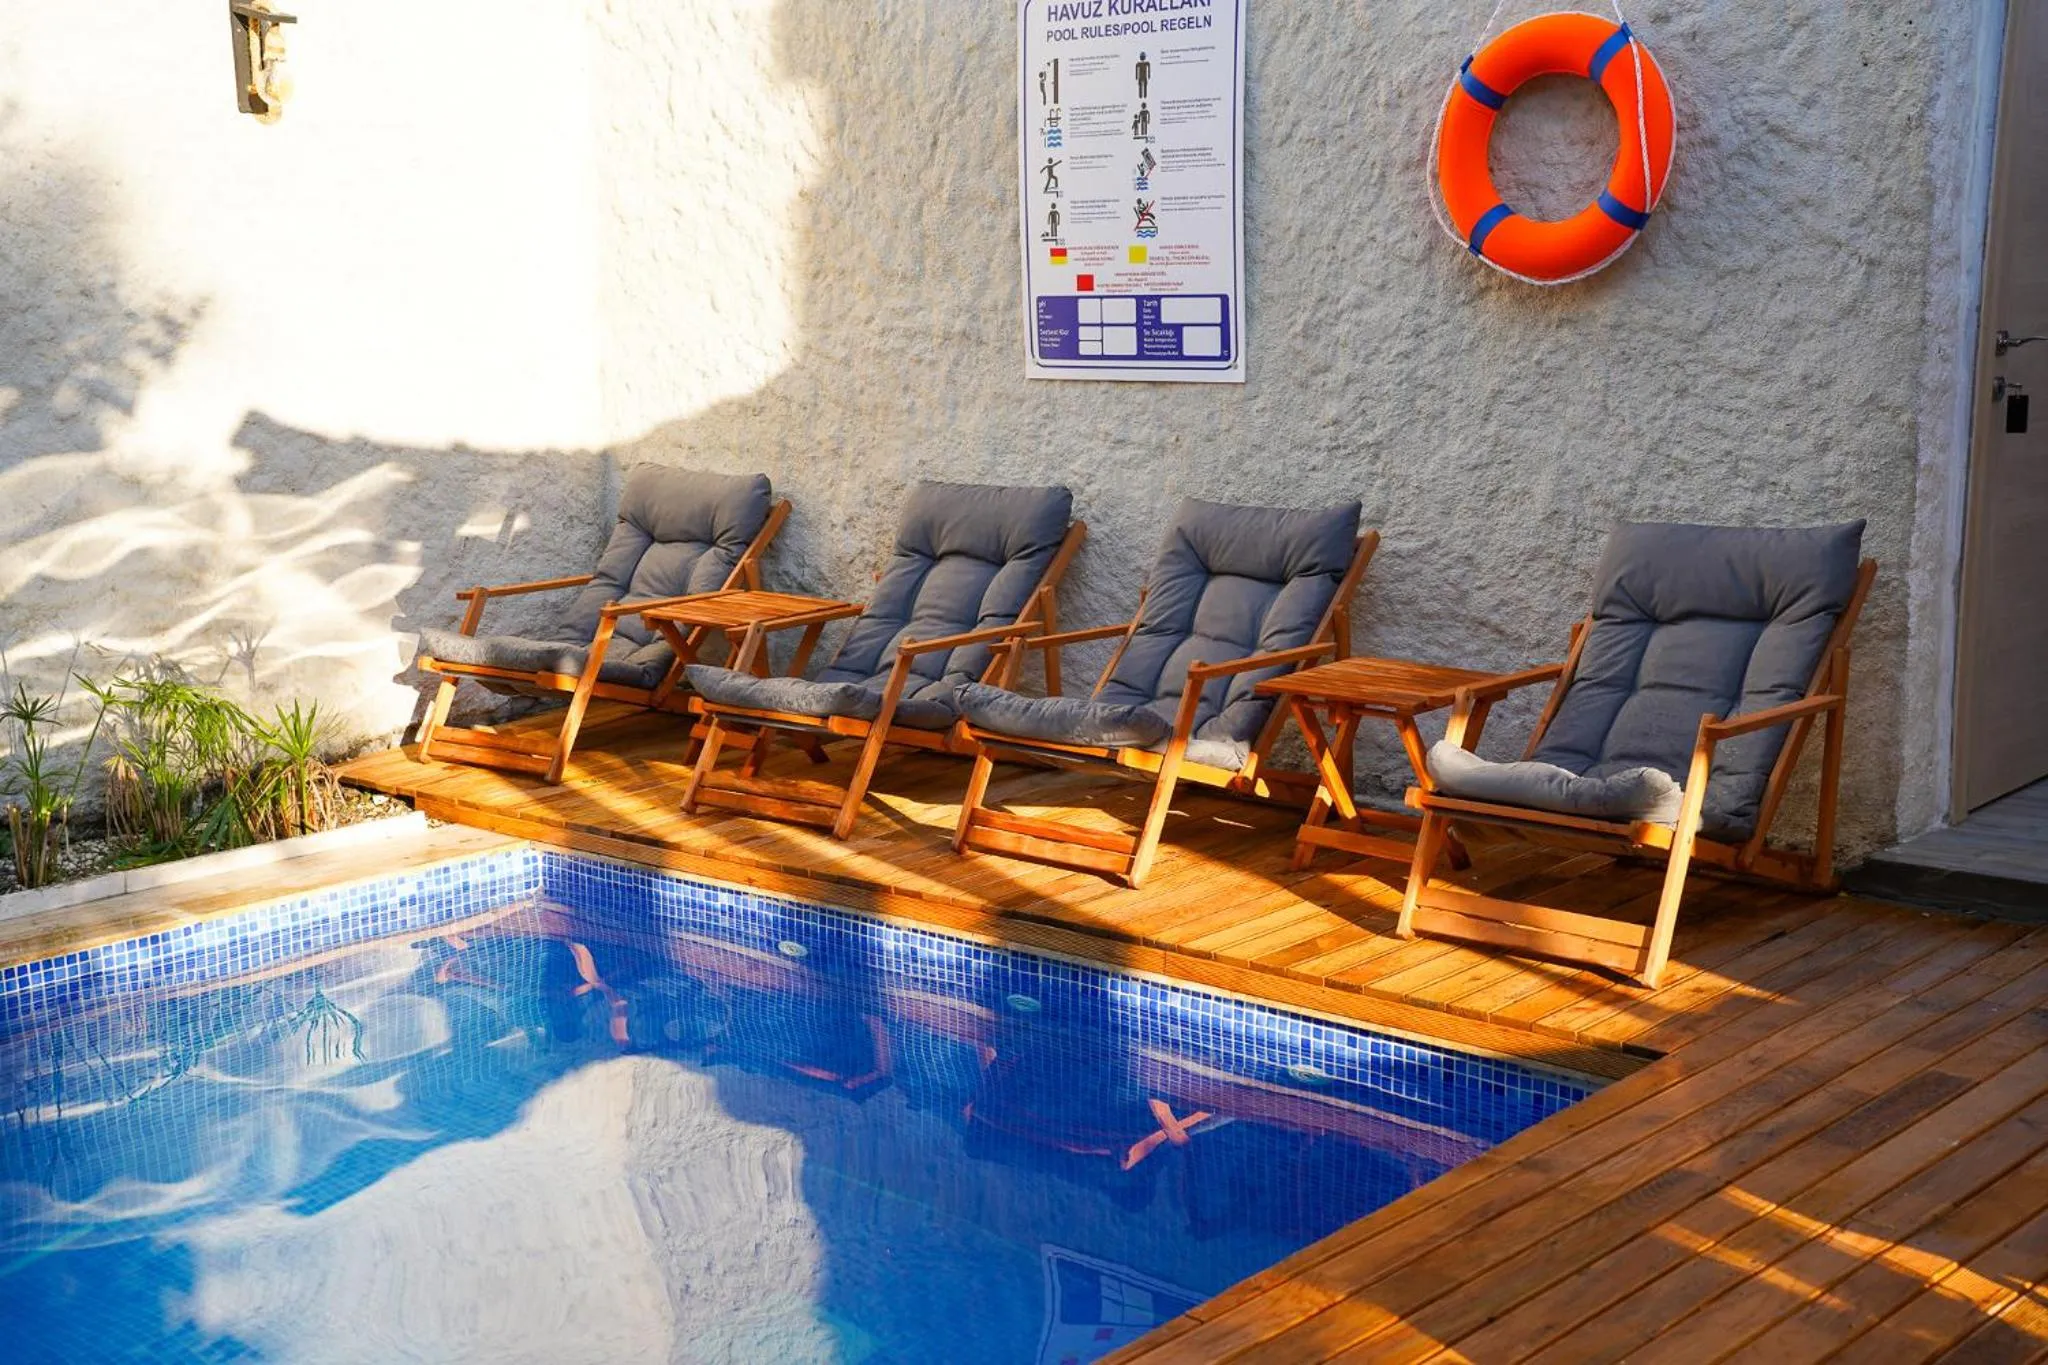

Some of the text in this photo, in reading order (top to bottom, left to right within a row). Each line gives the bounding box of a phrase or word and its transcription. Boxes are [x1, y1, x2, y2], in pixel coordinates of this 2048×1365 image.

[1047, 1, 1102, 22] HAVUZ
[1047, 15, 1212, 43] POOL RULES/POOL REGELN
